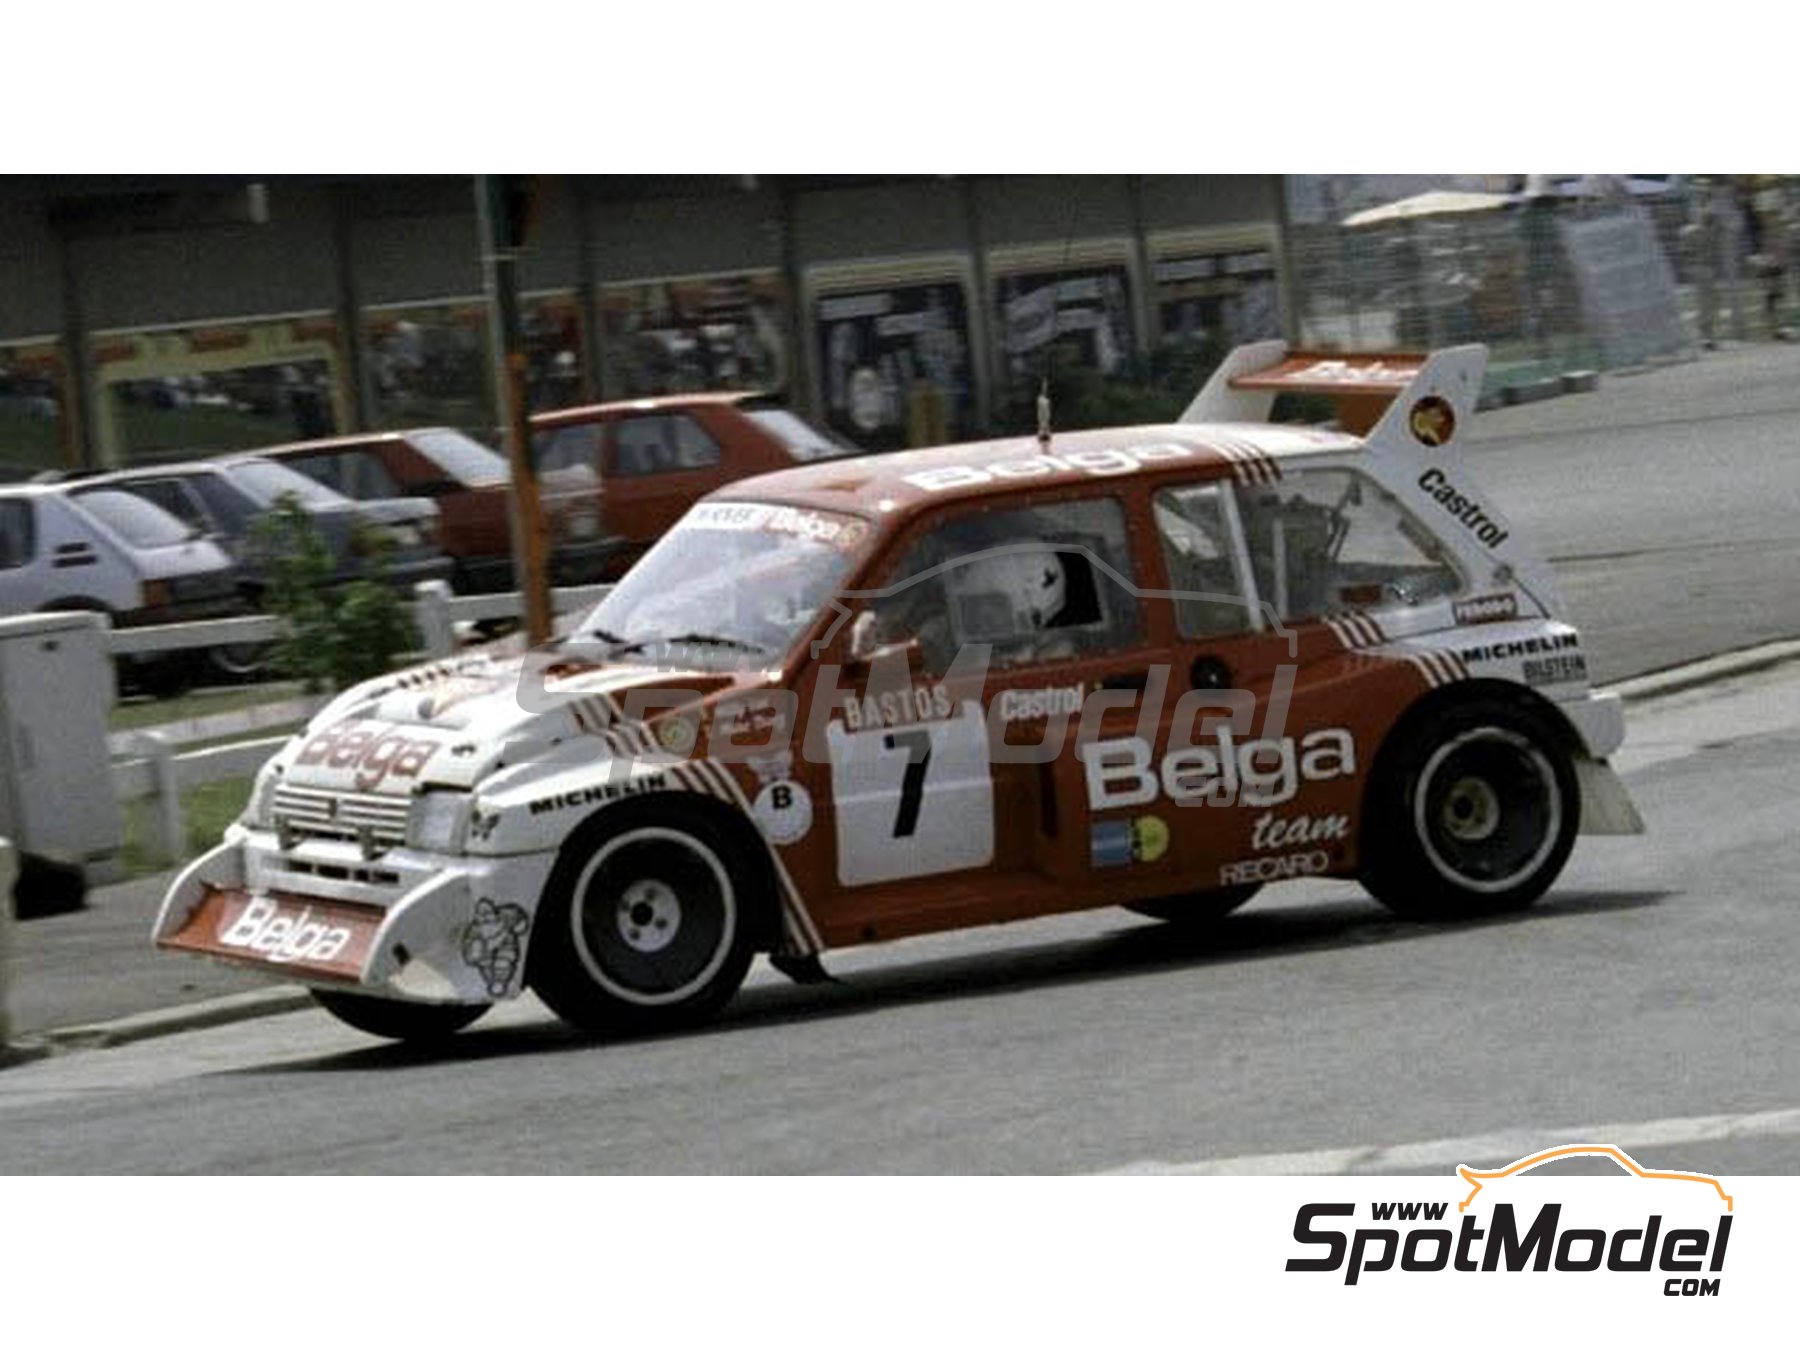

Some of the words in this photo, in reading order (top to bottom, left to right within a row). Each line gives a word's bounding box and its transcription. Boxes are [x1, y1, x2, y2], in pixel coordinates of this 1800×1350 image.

[1418, 468, 1508, 548] Castrol
[1462, 633, 1578, 662] MICHELIN
[844, 684, 950, 730] BASTOS
[1001, 681, 1084, 721] Castrol
[295, 718, 442, 792] Belga
[1080, 725, 1357, 811] Belga
[529, 773, 665, 815] MICHELIN
[772, 785, 793, 810] B
[883, 730, 932, 838] 7
[1252, 813, 1349, 850] team
[1219, 850, 1328, 887] RECARO
[220, 896, 351, 962] Belga
